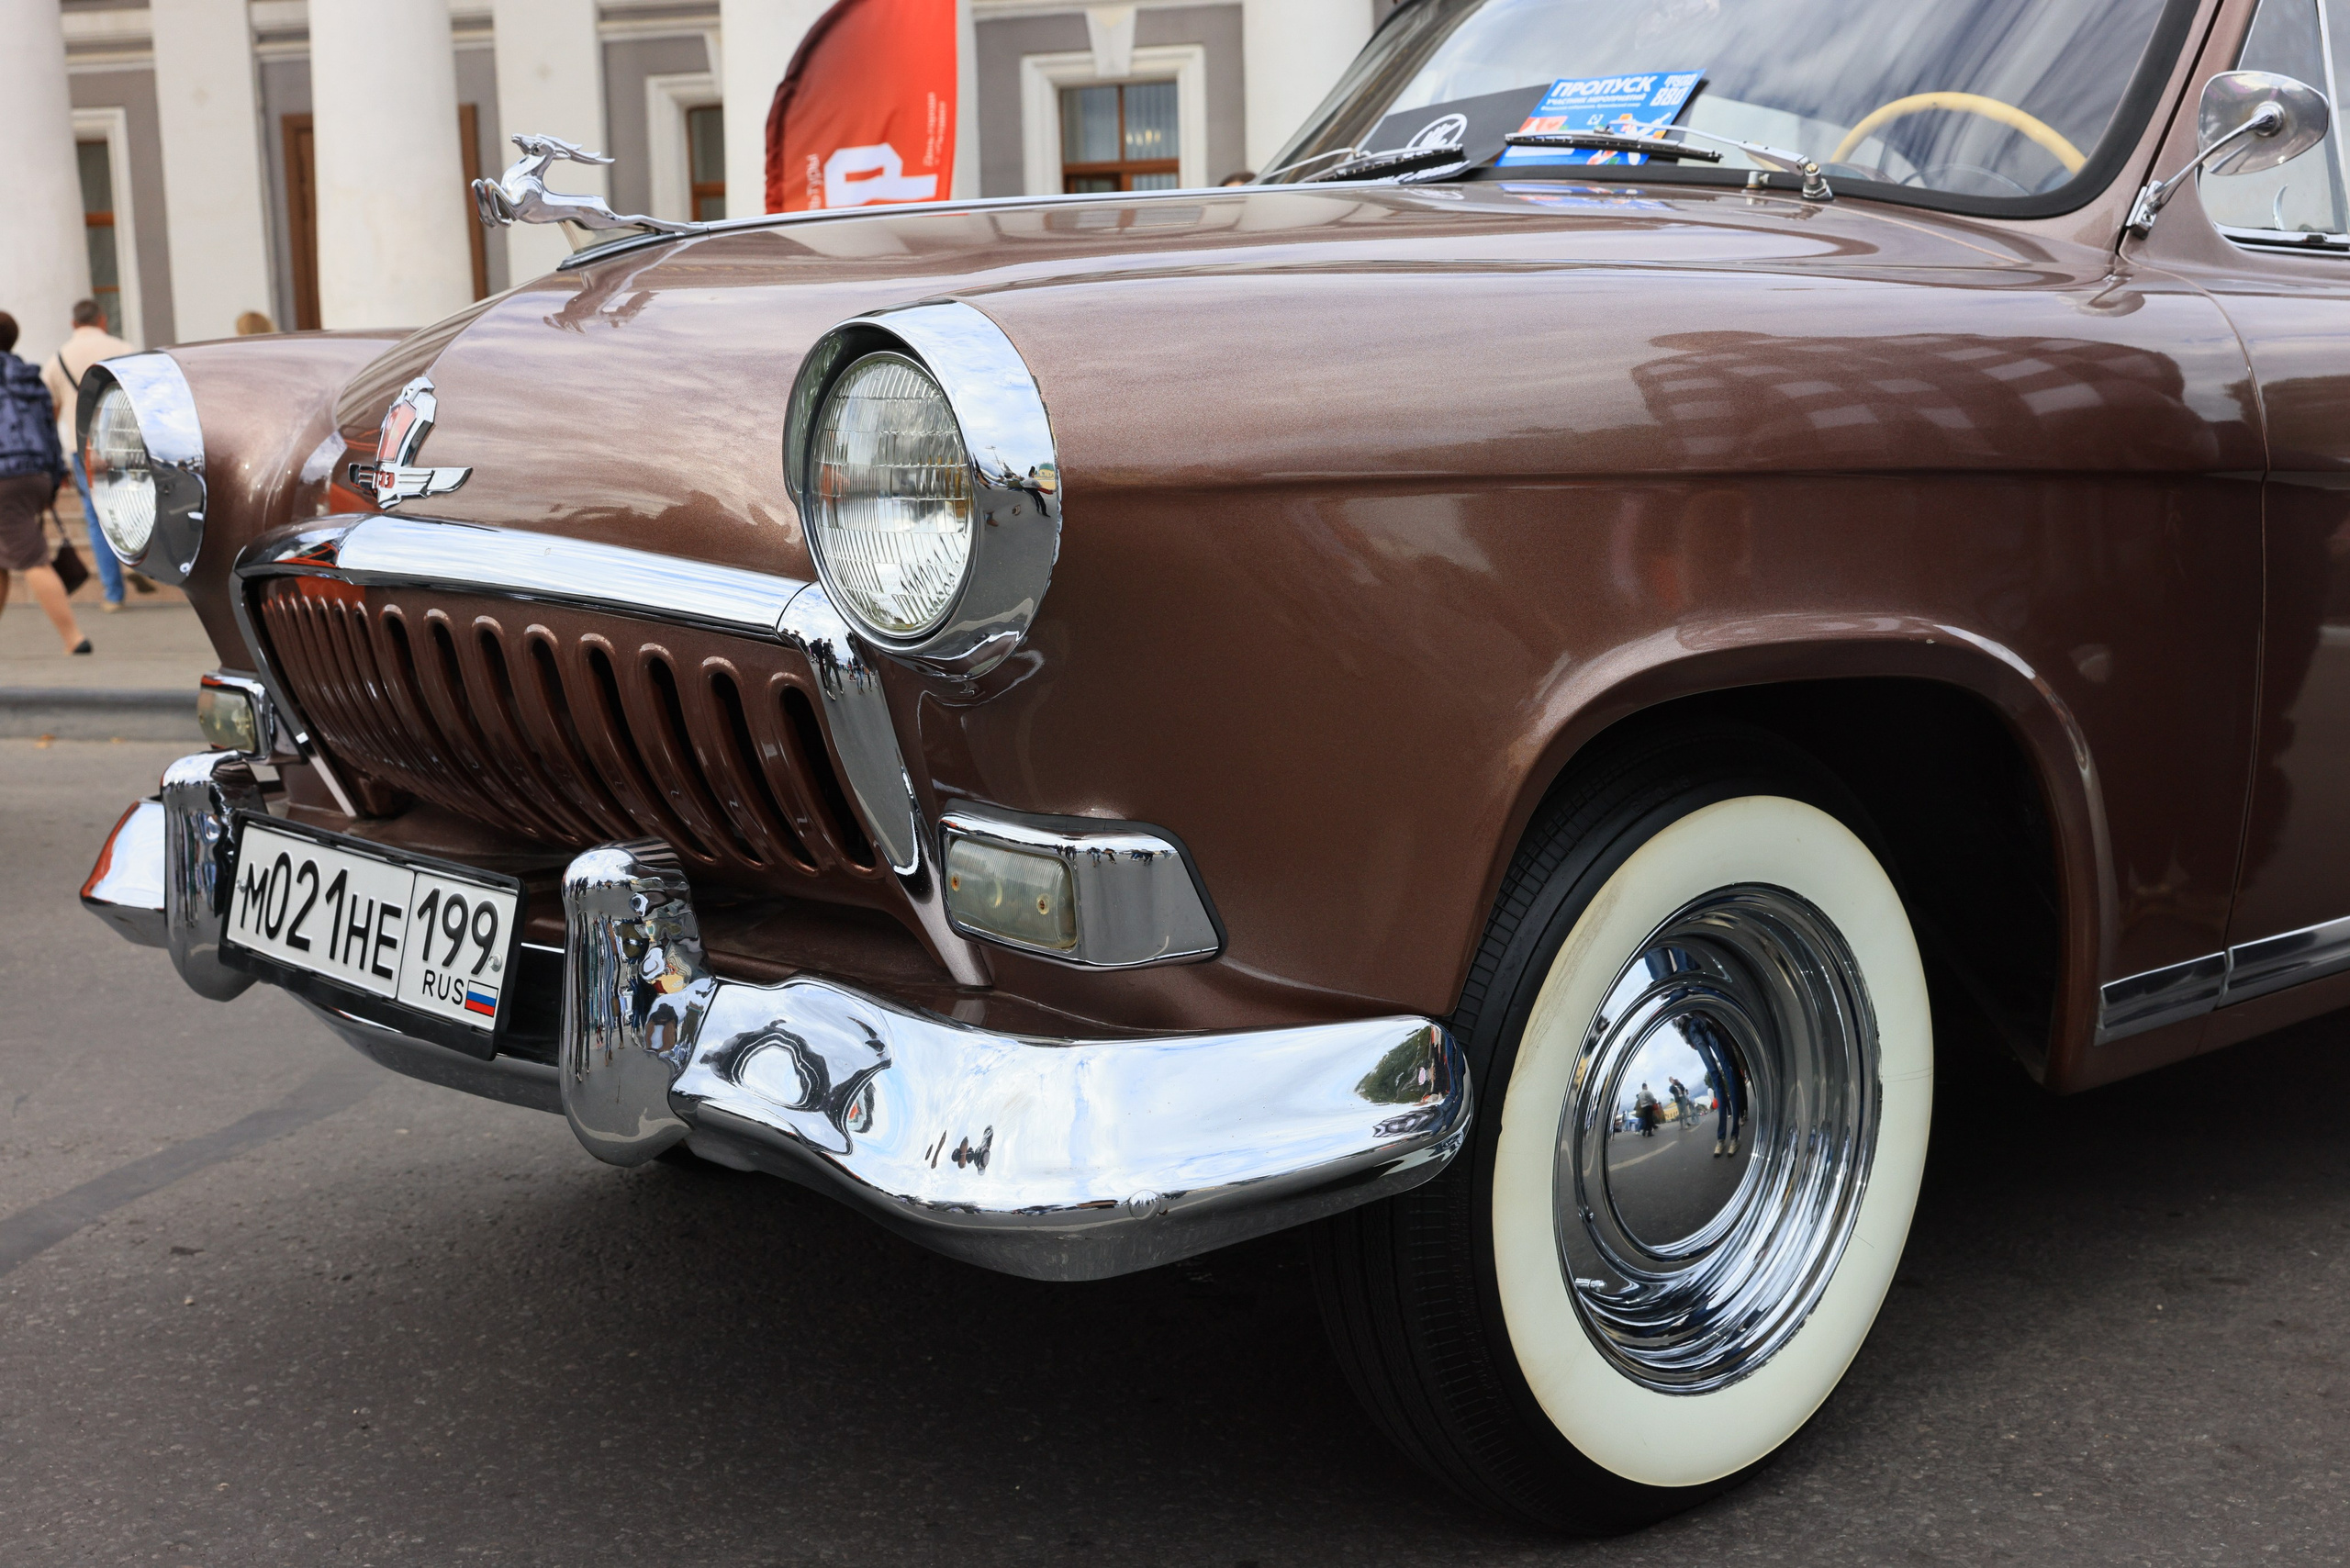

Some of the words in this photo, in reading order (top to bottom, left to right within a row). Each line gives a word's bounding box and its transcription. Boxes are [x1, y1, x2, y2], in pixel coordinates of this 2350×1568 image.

[1551, 76, 1658, 96] ПРОПУСК
[1651, 87, 1687, 106] 880
[417, 888, 498, 975] 199
[422, 969, 464, 1005] RUS
